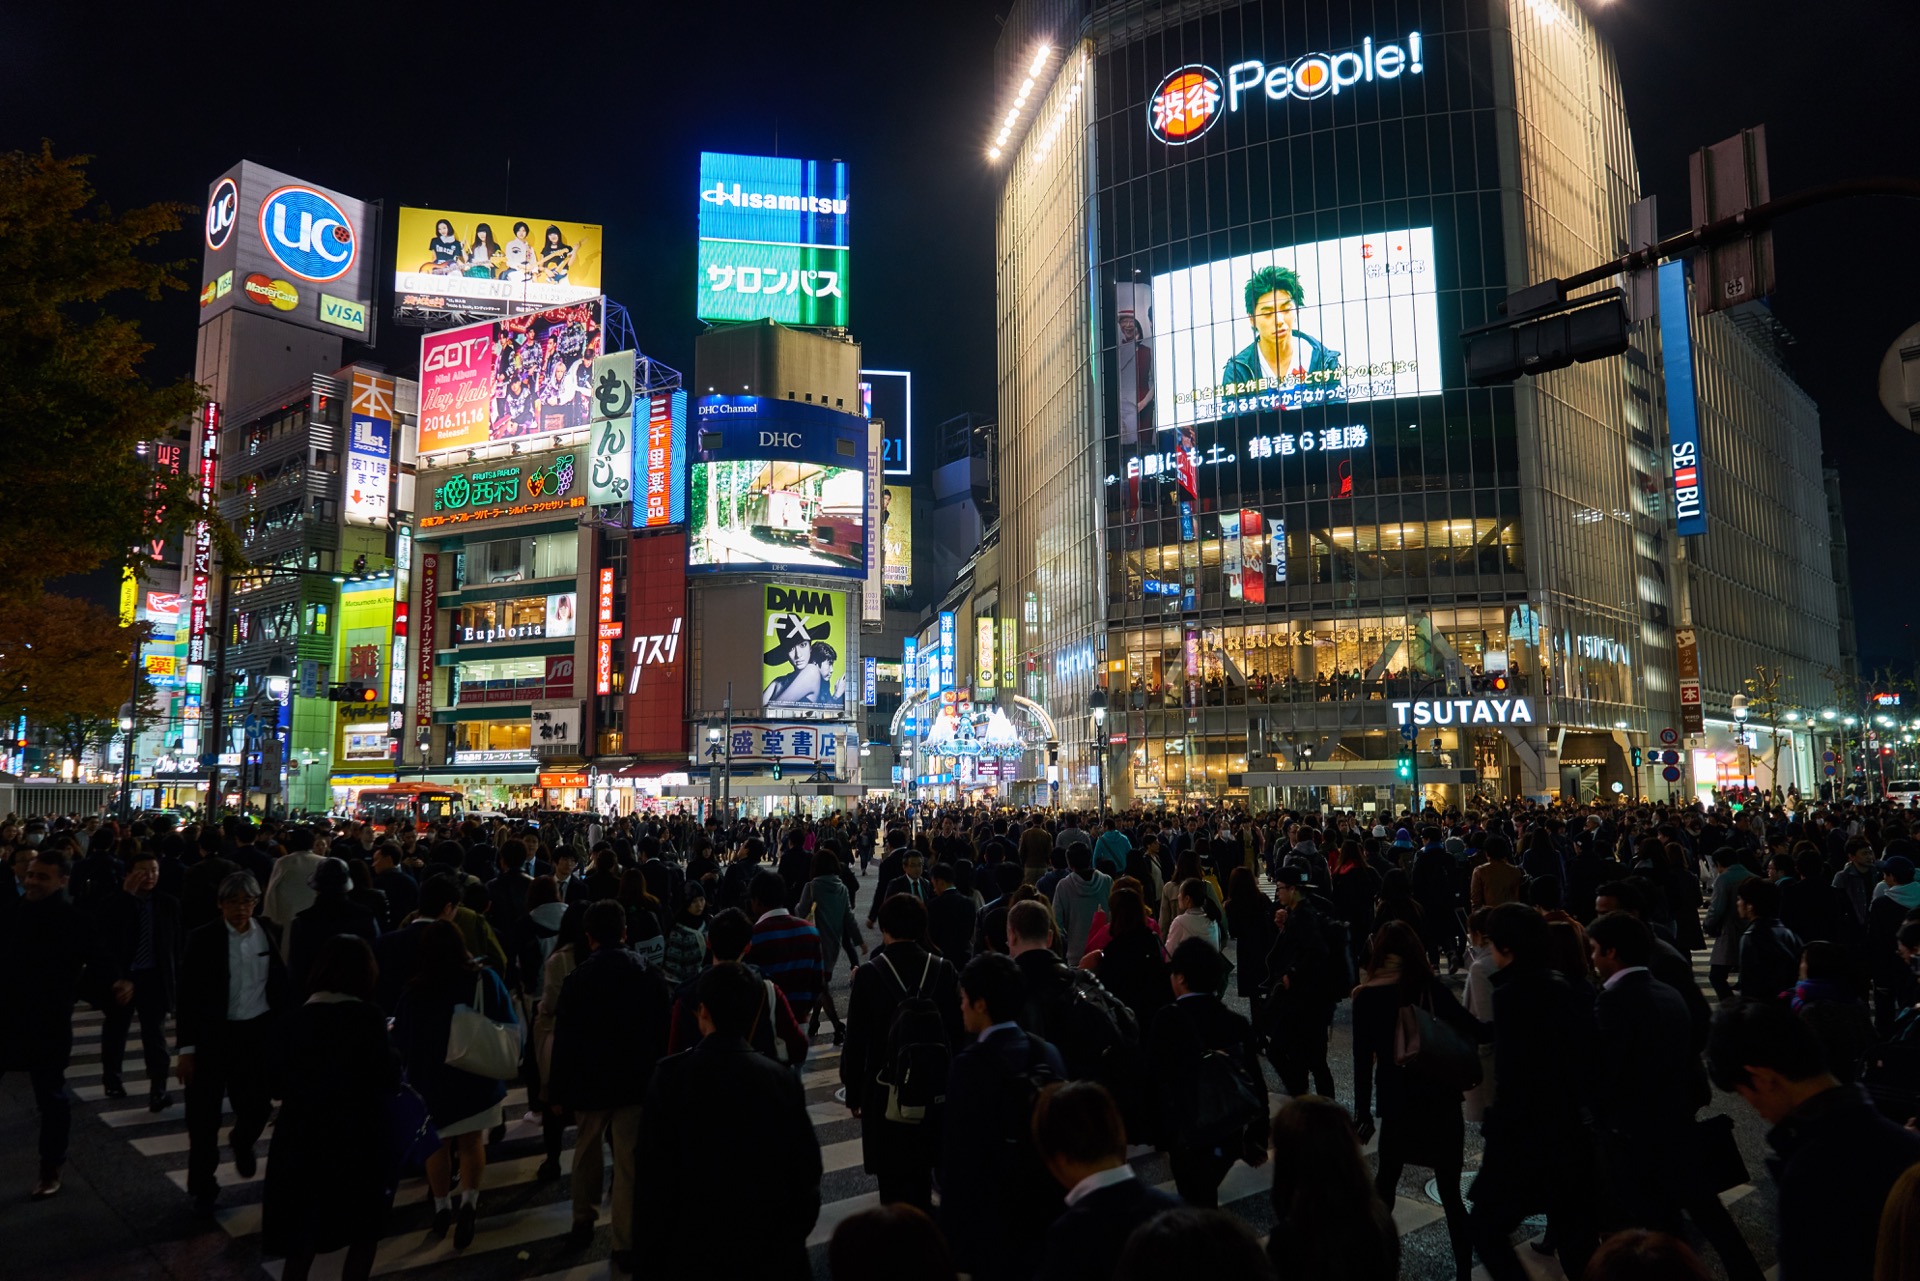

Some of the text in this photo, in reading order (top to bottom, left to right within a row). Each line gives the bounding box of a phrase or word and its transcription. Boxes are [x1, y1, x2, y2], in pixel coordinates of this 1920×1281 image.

[1152, 31, 1423, 131] 渋谷 People!
[701, 182, 848, 215] Hisamitsu
[246, 281, 299, 304] MasterCard
[707, 264, 842, 298] サロンパス
[326, 303, 363, 325] VISA
[424, 336, 489, 373] GOT7
[435, 368, 477, 385] Mini Album
[422, 377, 489, 411] Hey Yah
[423, 408, 484, 432] 2016.11.16
[698, 404, 758, 415] DHC Channel
[437, 426, 470, 440] Release!!
[592, 368, 633, 499] もんじゃ
[759, 431, 802, 448] DHC
[351, 458, 388, 476] 夜11時
[646, 398, 667, 518] 三千里薬品
[357, 473, 380, 488] まで
[472, 467, 520, 481] FRUITS&PARLOR
[867, 446, 879, 511] Taisei
[1671, 441, 1701, 520] SEIBU
[767, 586, 834, 616] DMM
[421, 577, 434, 672] ウィンターフルーツギフト
[464, 624, 542, 643] Euphoria
[766, 613, 811, 640] FX
[941, 615, 954, 685] 洋服の青山
[1188, 625, 1417, 653] STARBUCKS COFFEE
[150, 657, 171, 674] 薬
[350, 644, 379, 680] 薬
[547, 660, 573, 681] JTB
[1683, 688, 1698, 701] 本
[1393, 699, 1532, 724] TSUTAYA
